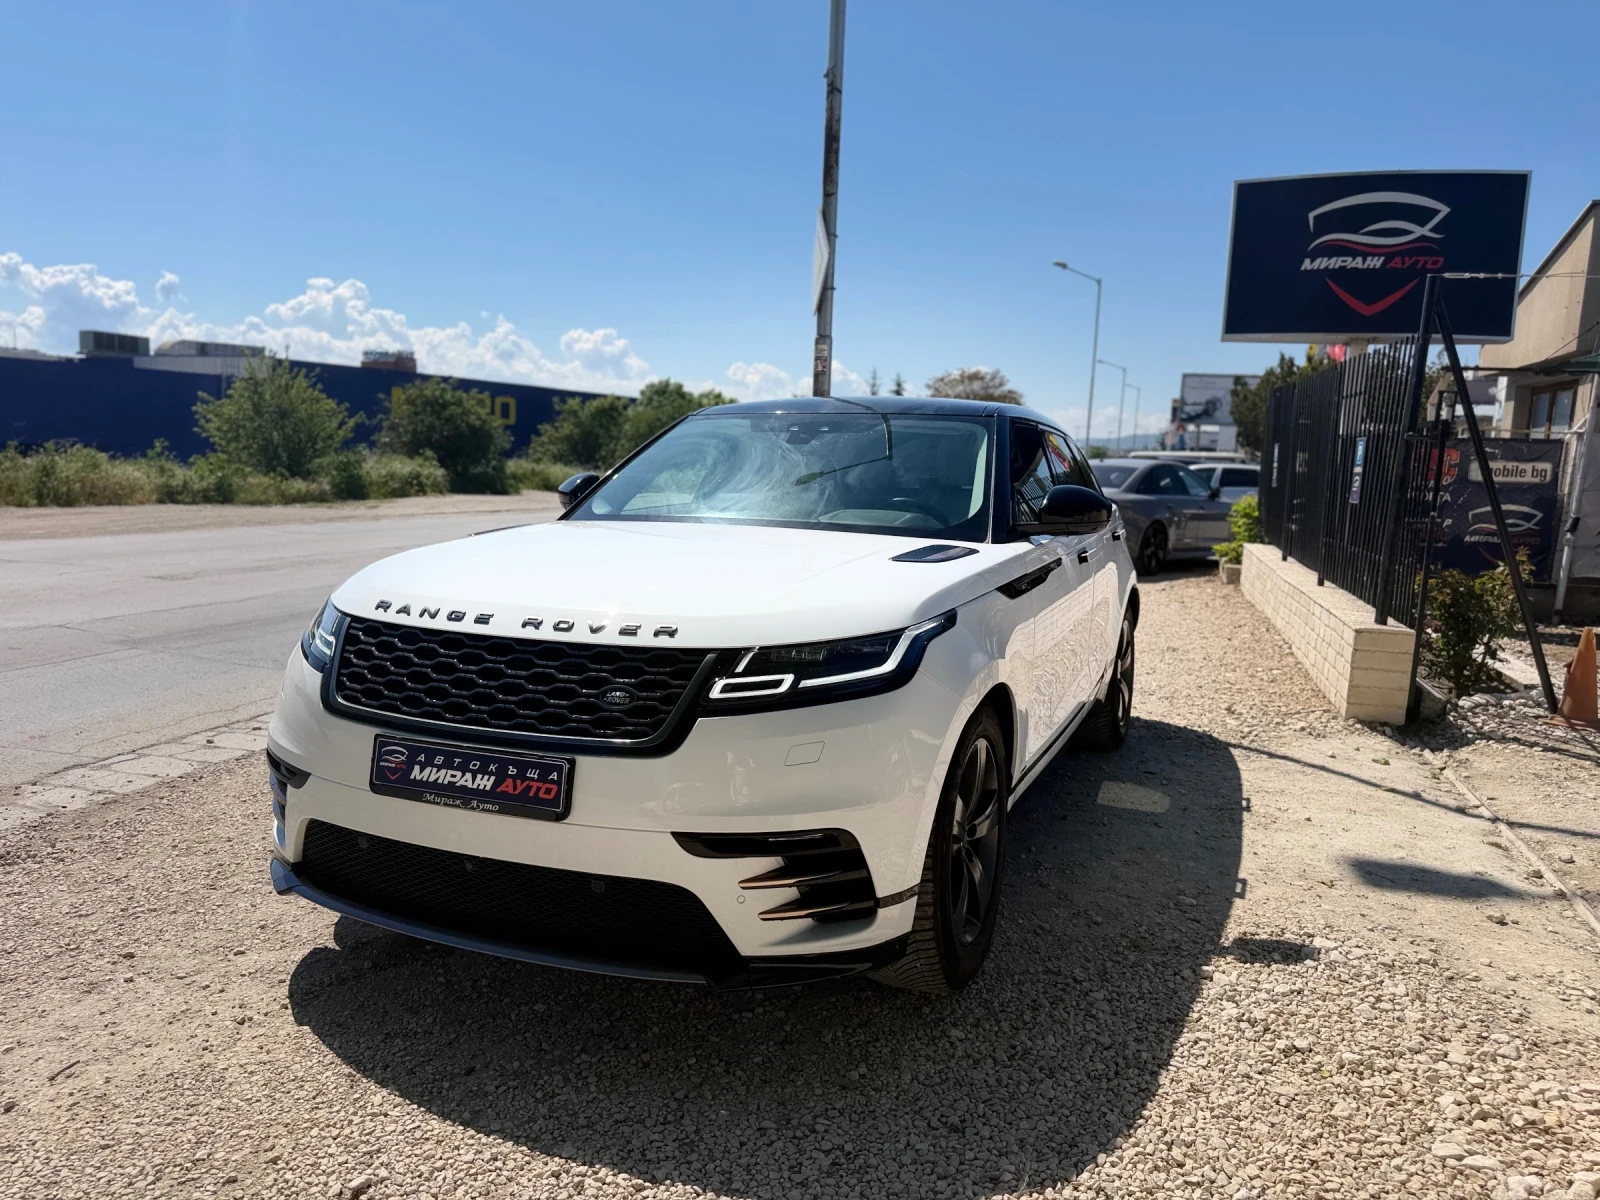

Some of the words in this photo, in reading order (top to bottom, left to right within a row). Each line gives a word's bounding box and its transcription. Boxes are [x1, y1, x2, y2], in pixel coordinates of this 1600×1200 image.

[1300, 256, 1385, 270] МИРАЖ
[1385, 256, 1445, 269] АУТО
[1490, 465, 1527, 478] obile
[1463, 534, 1501, 543] МИРА
[374, 599, 494, 625] RANGE
[521, 615, 679, 638] ROVER
[416, 753, 558, 780] АВТОКЪЩА
[410, 764, 496, 791] МИРАЖ
[496, 778, 558, 800] АУТО
[422, 792, 465, 808] Мираж
[467, 800, 499, 811] Ауто
